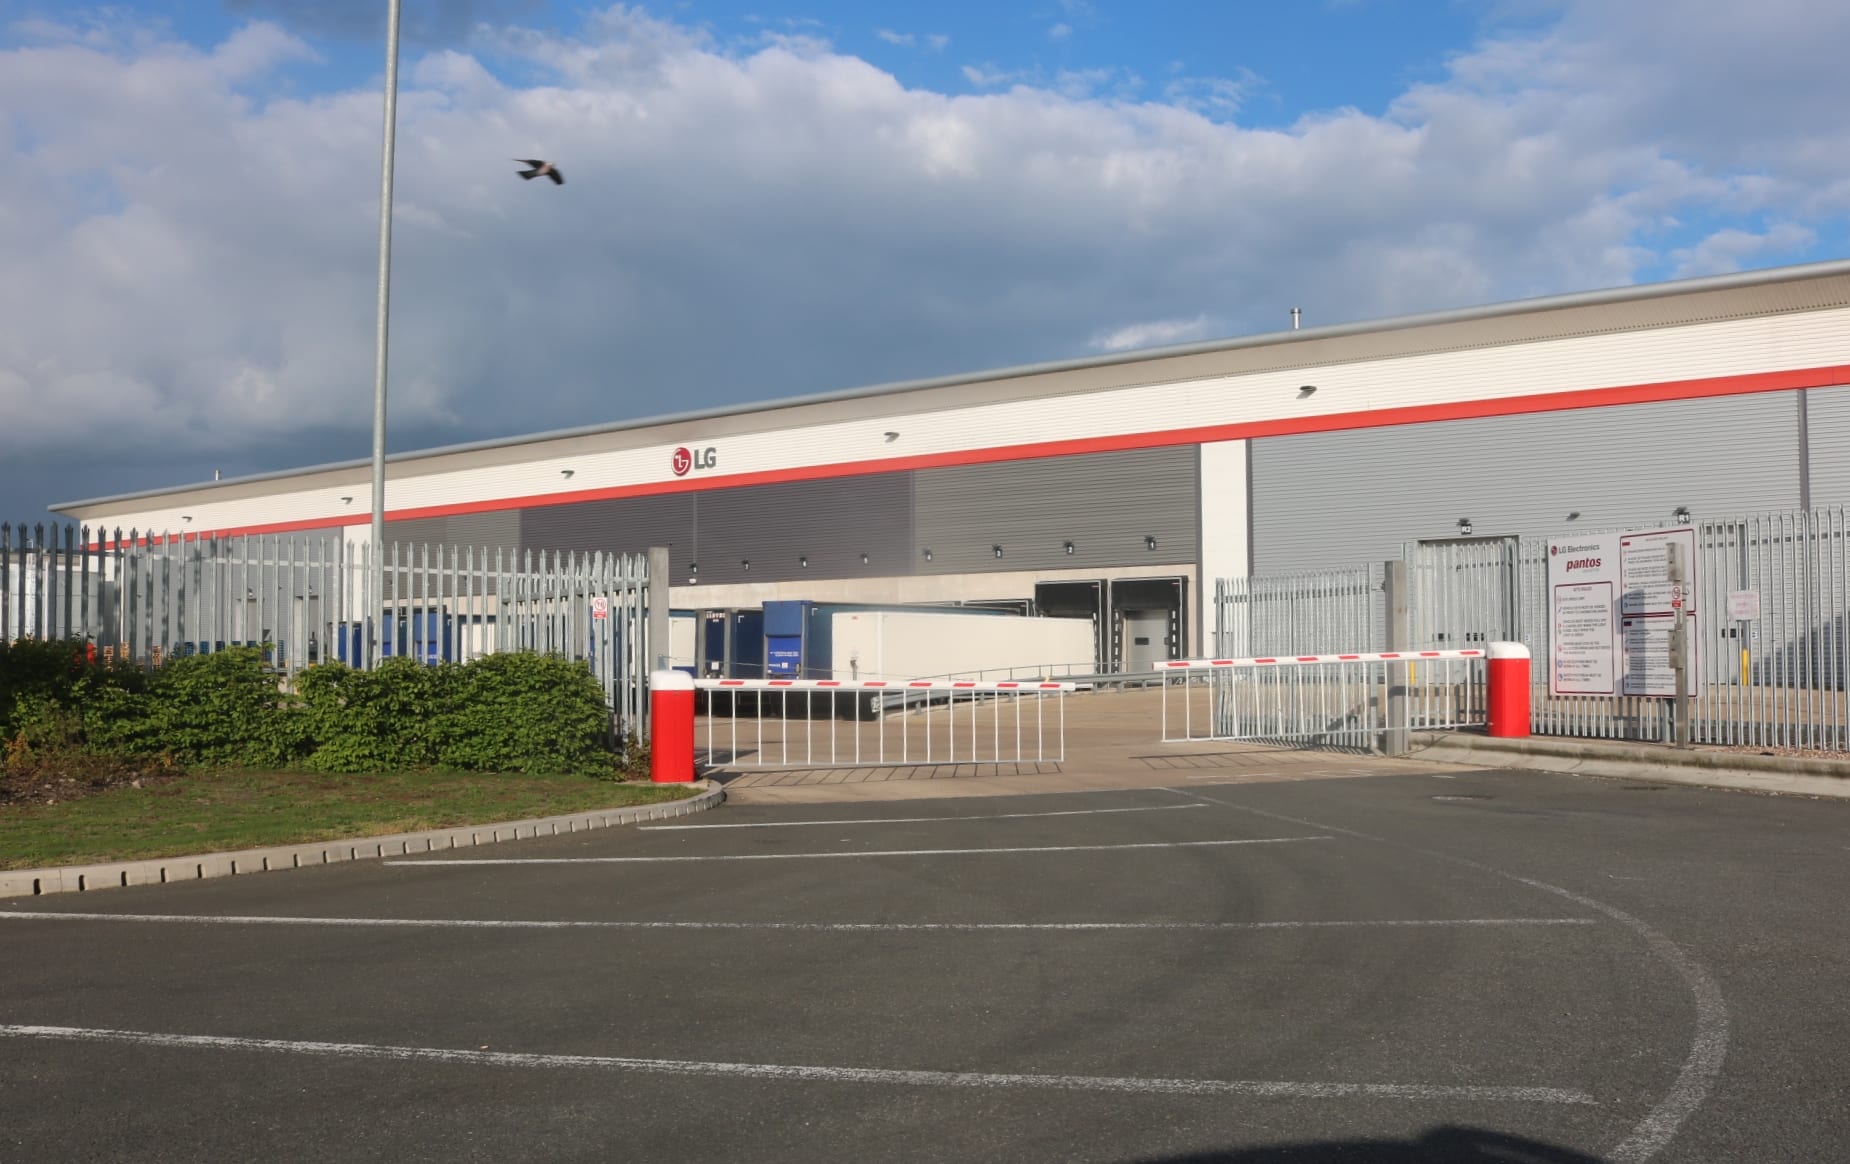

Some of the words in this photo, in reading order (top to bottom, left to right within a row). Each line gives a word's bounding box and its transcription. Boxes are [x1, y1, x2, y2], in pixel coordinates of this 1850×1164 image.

[694, 447, 717, 469] LG
[1679, 514, 1689, 522] R1
[1558, 546, 1567, 554] LG
[1568, 544, 1600, 553] Electronics
[1566, 557, 1602, 573] pantos
